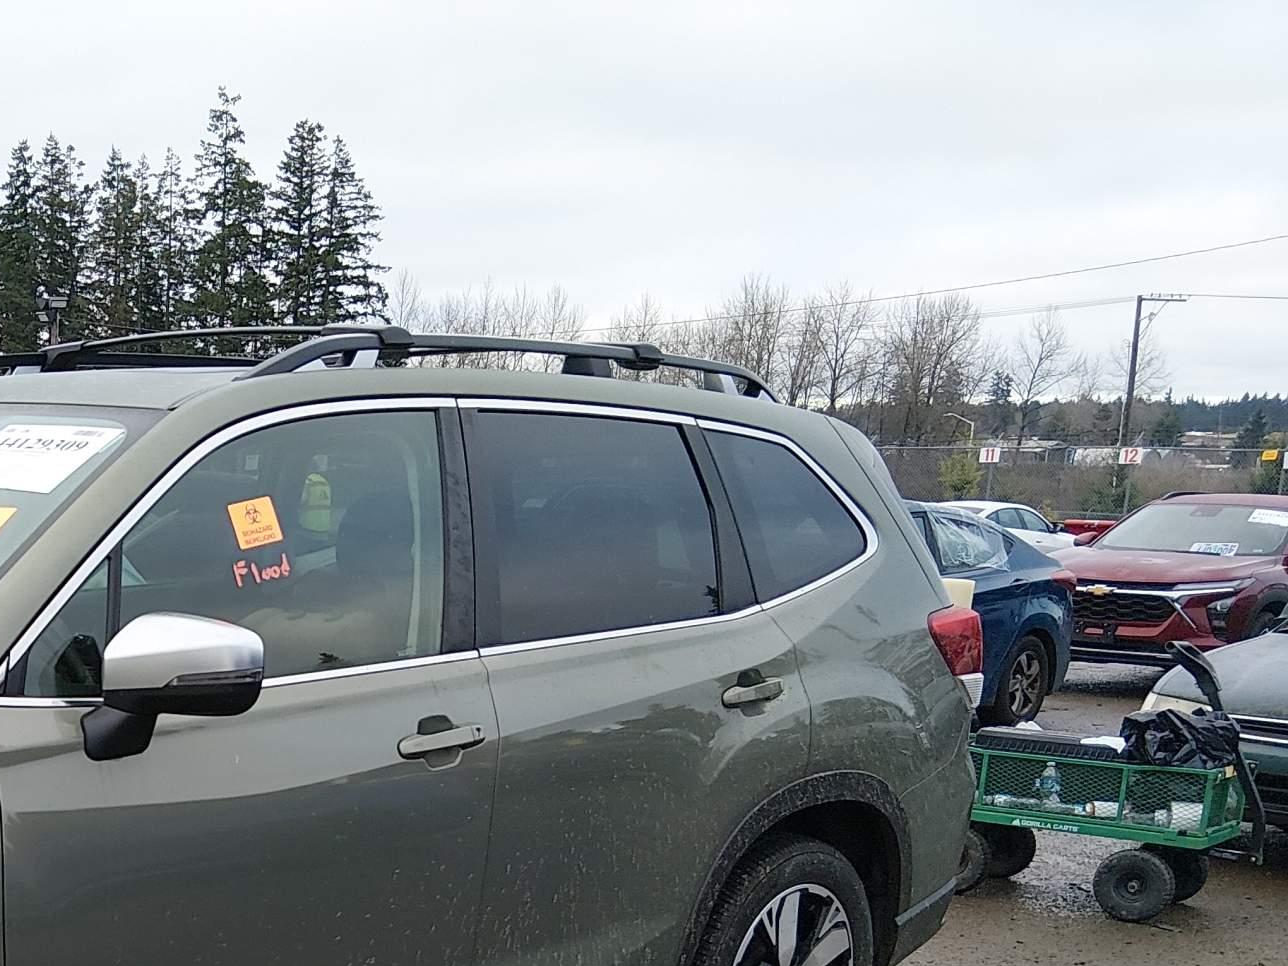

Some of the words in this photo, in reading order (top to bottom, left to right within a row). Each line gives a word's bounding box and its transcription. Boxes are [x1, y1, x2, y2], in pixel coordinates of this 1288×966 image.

[985, 448, 995, 462] 11
[1124, 448, 1140, 463] 12
[242, 524, 273, 537] BIOHAZARD
[232, 553, 290, 588] Flood
[1021, 819, 1051, 829] GORILLA
[1052, 823, 1079, 832] CARTS
